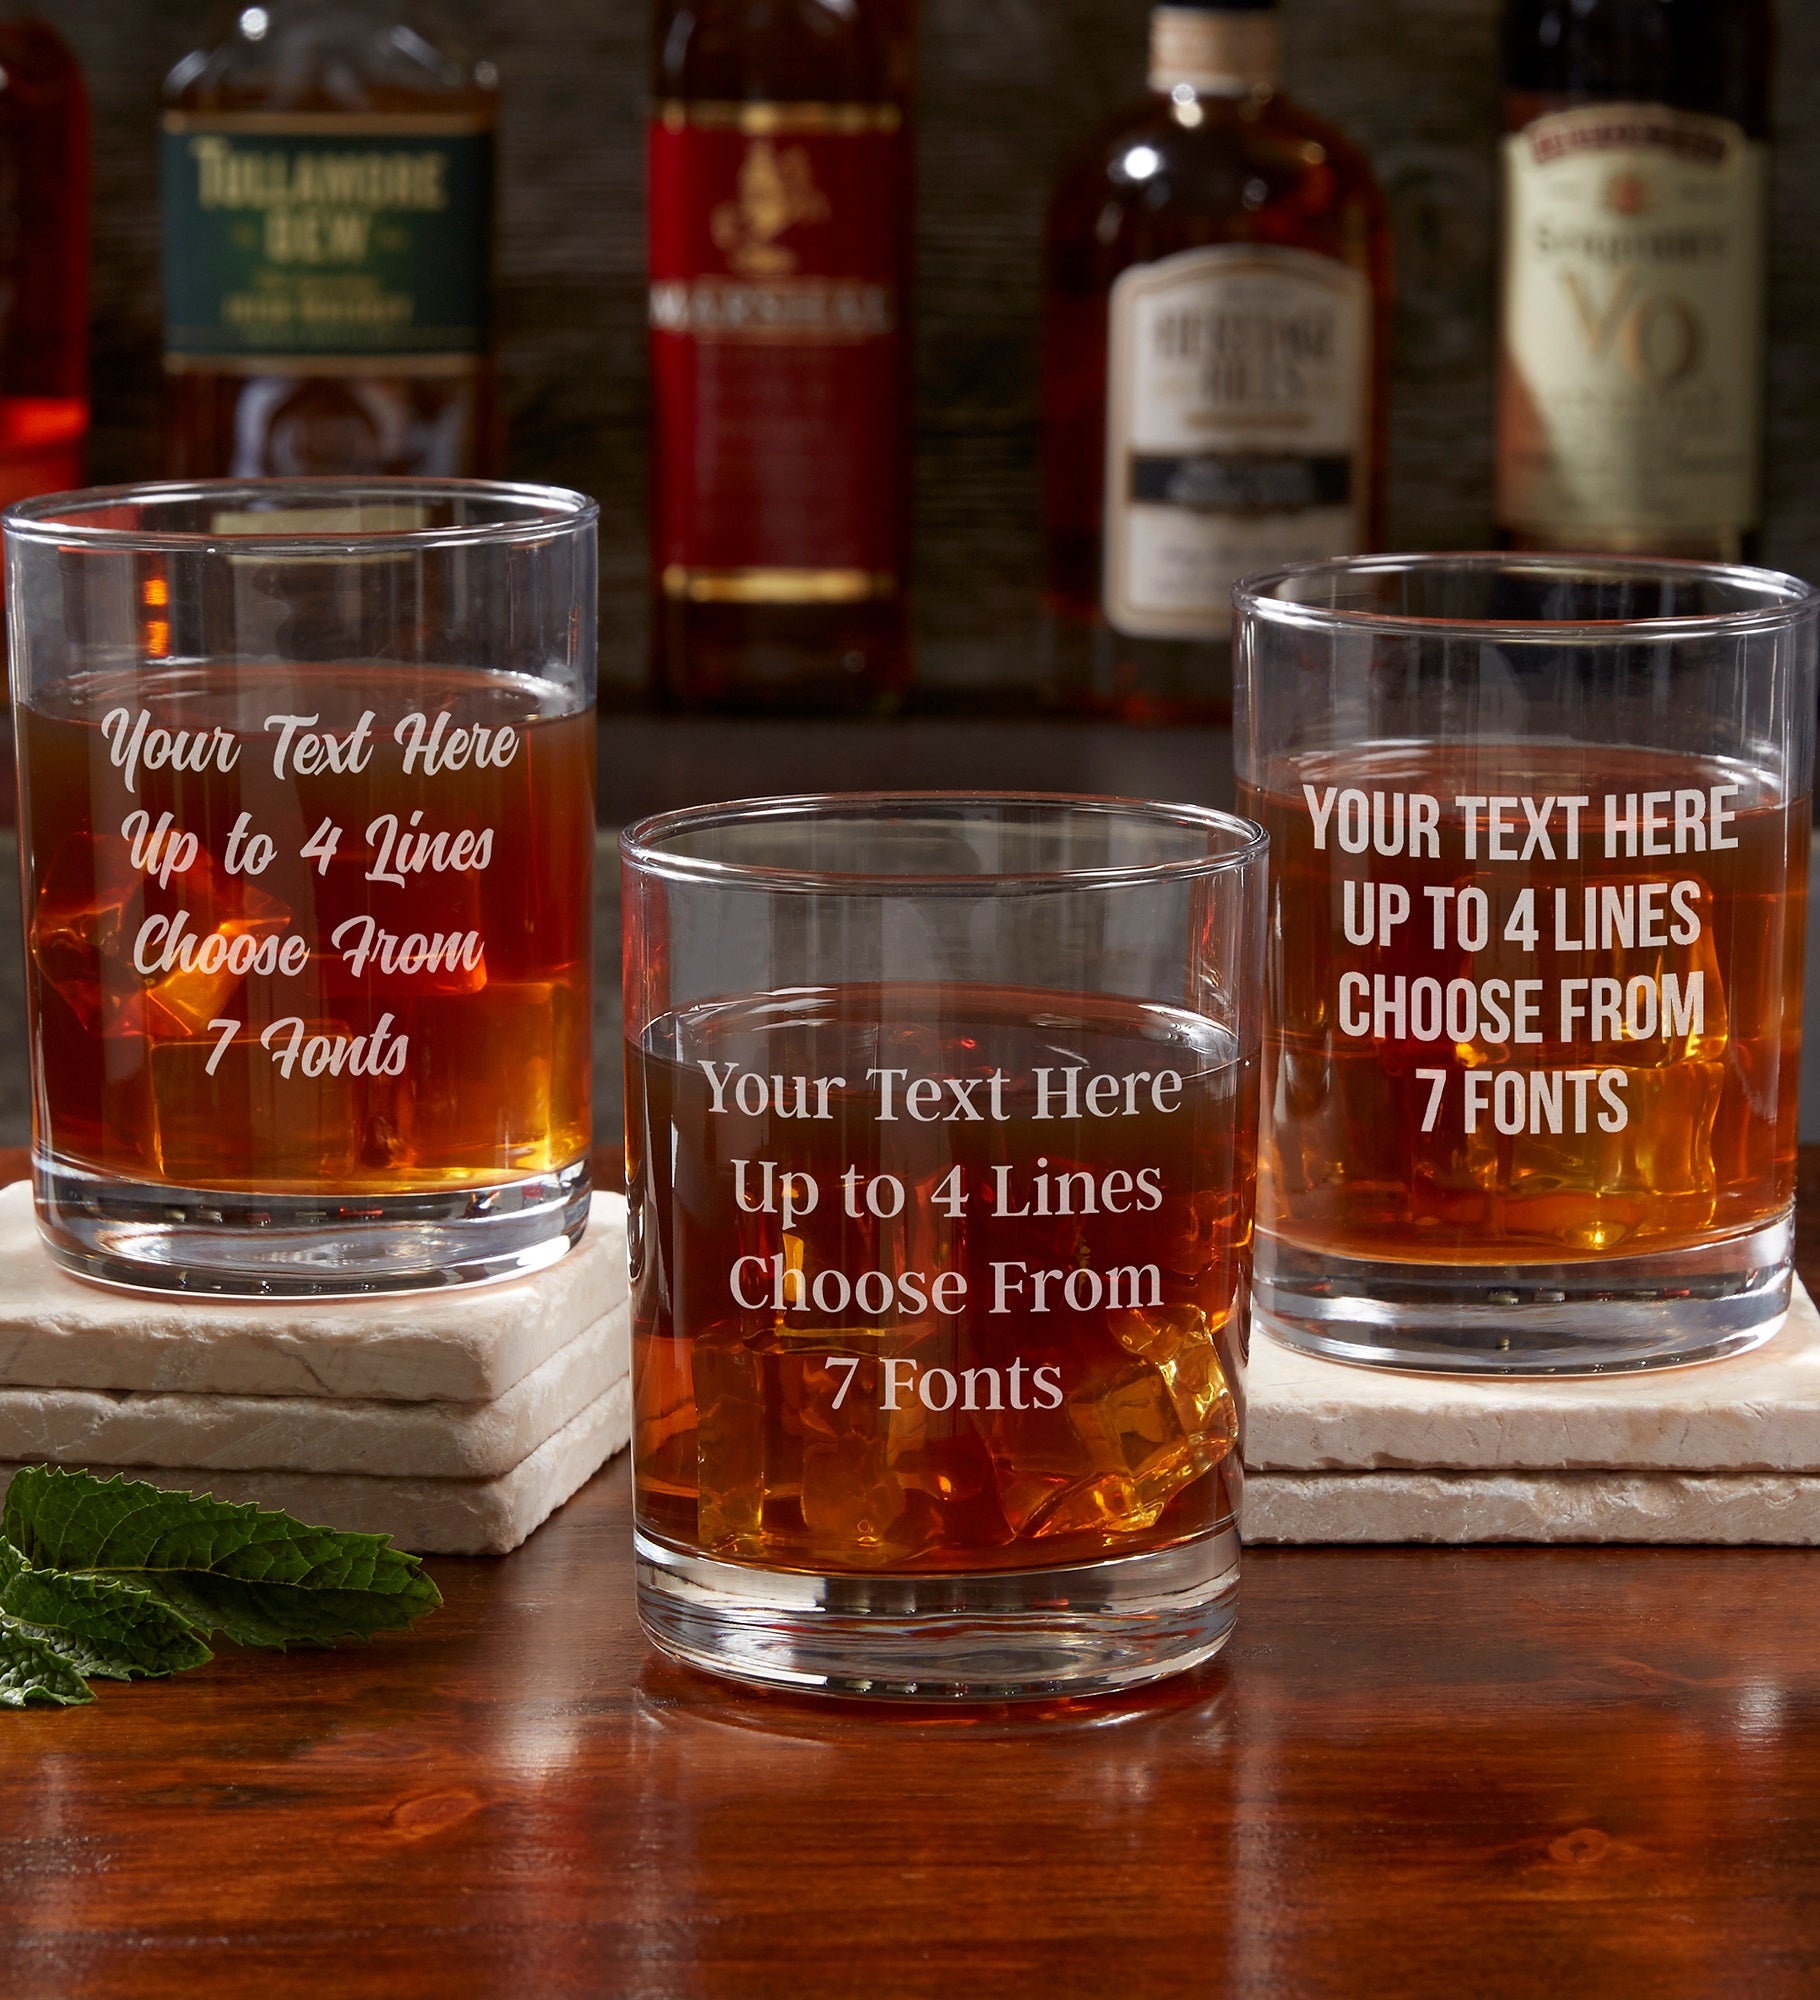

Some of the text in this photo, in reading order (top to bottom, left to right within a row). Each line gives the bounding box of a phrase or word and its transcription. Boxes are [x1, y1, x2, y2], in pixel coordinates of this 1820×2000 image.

[102, 708, 519, 792] Your Text Here
[122, 811, 493, 889] Up to 4 Lines
[1303, 784, 1739, 860] YOUR TEXT HERE
[133, 910, 485, 978] Choose From
[1344, 880, 1700, 952] UP TO 4 LINES
[1340, 972, 1703, 1043] CHOOSE FROM
[206, 1013, 408, 1079] 7 Fonts
[697, 1060, 1182, 1121] Your Text Here
[1416, 1069, 1627, 1135] 7 FONTS
[731, 1158, 1162, 1230] Up to 4 Lines
[730, 1255, 1164, 1315] Choose From
[826, 1357, 1062, 1410] 7 Fonts
